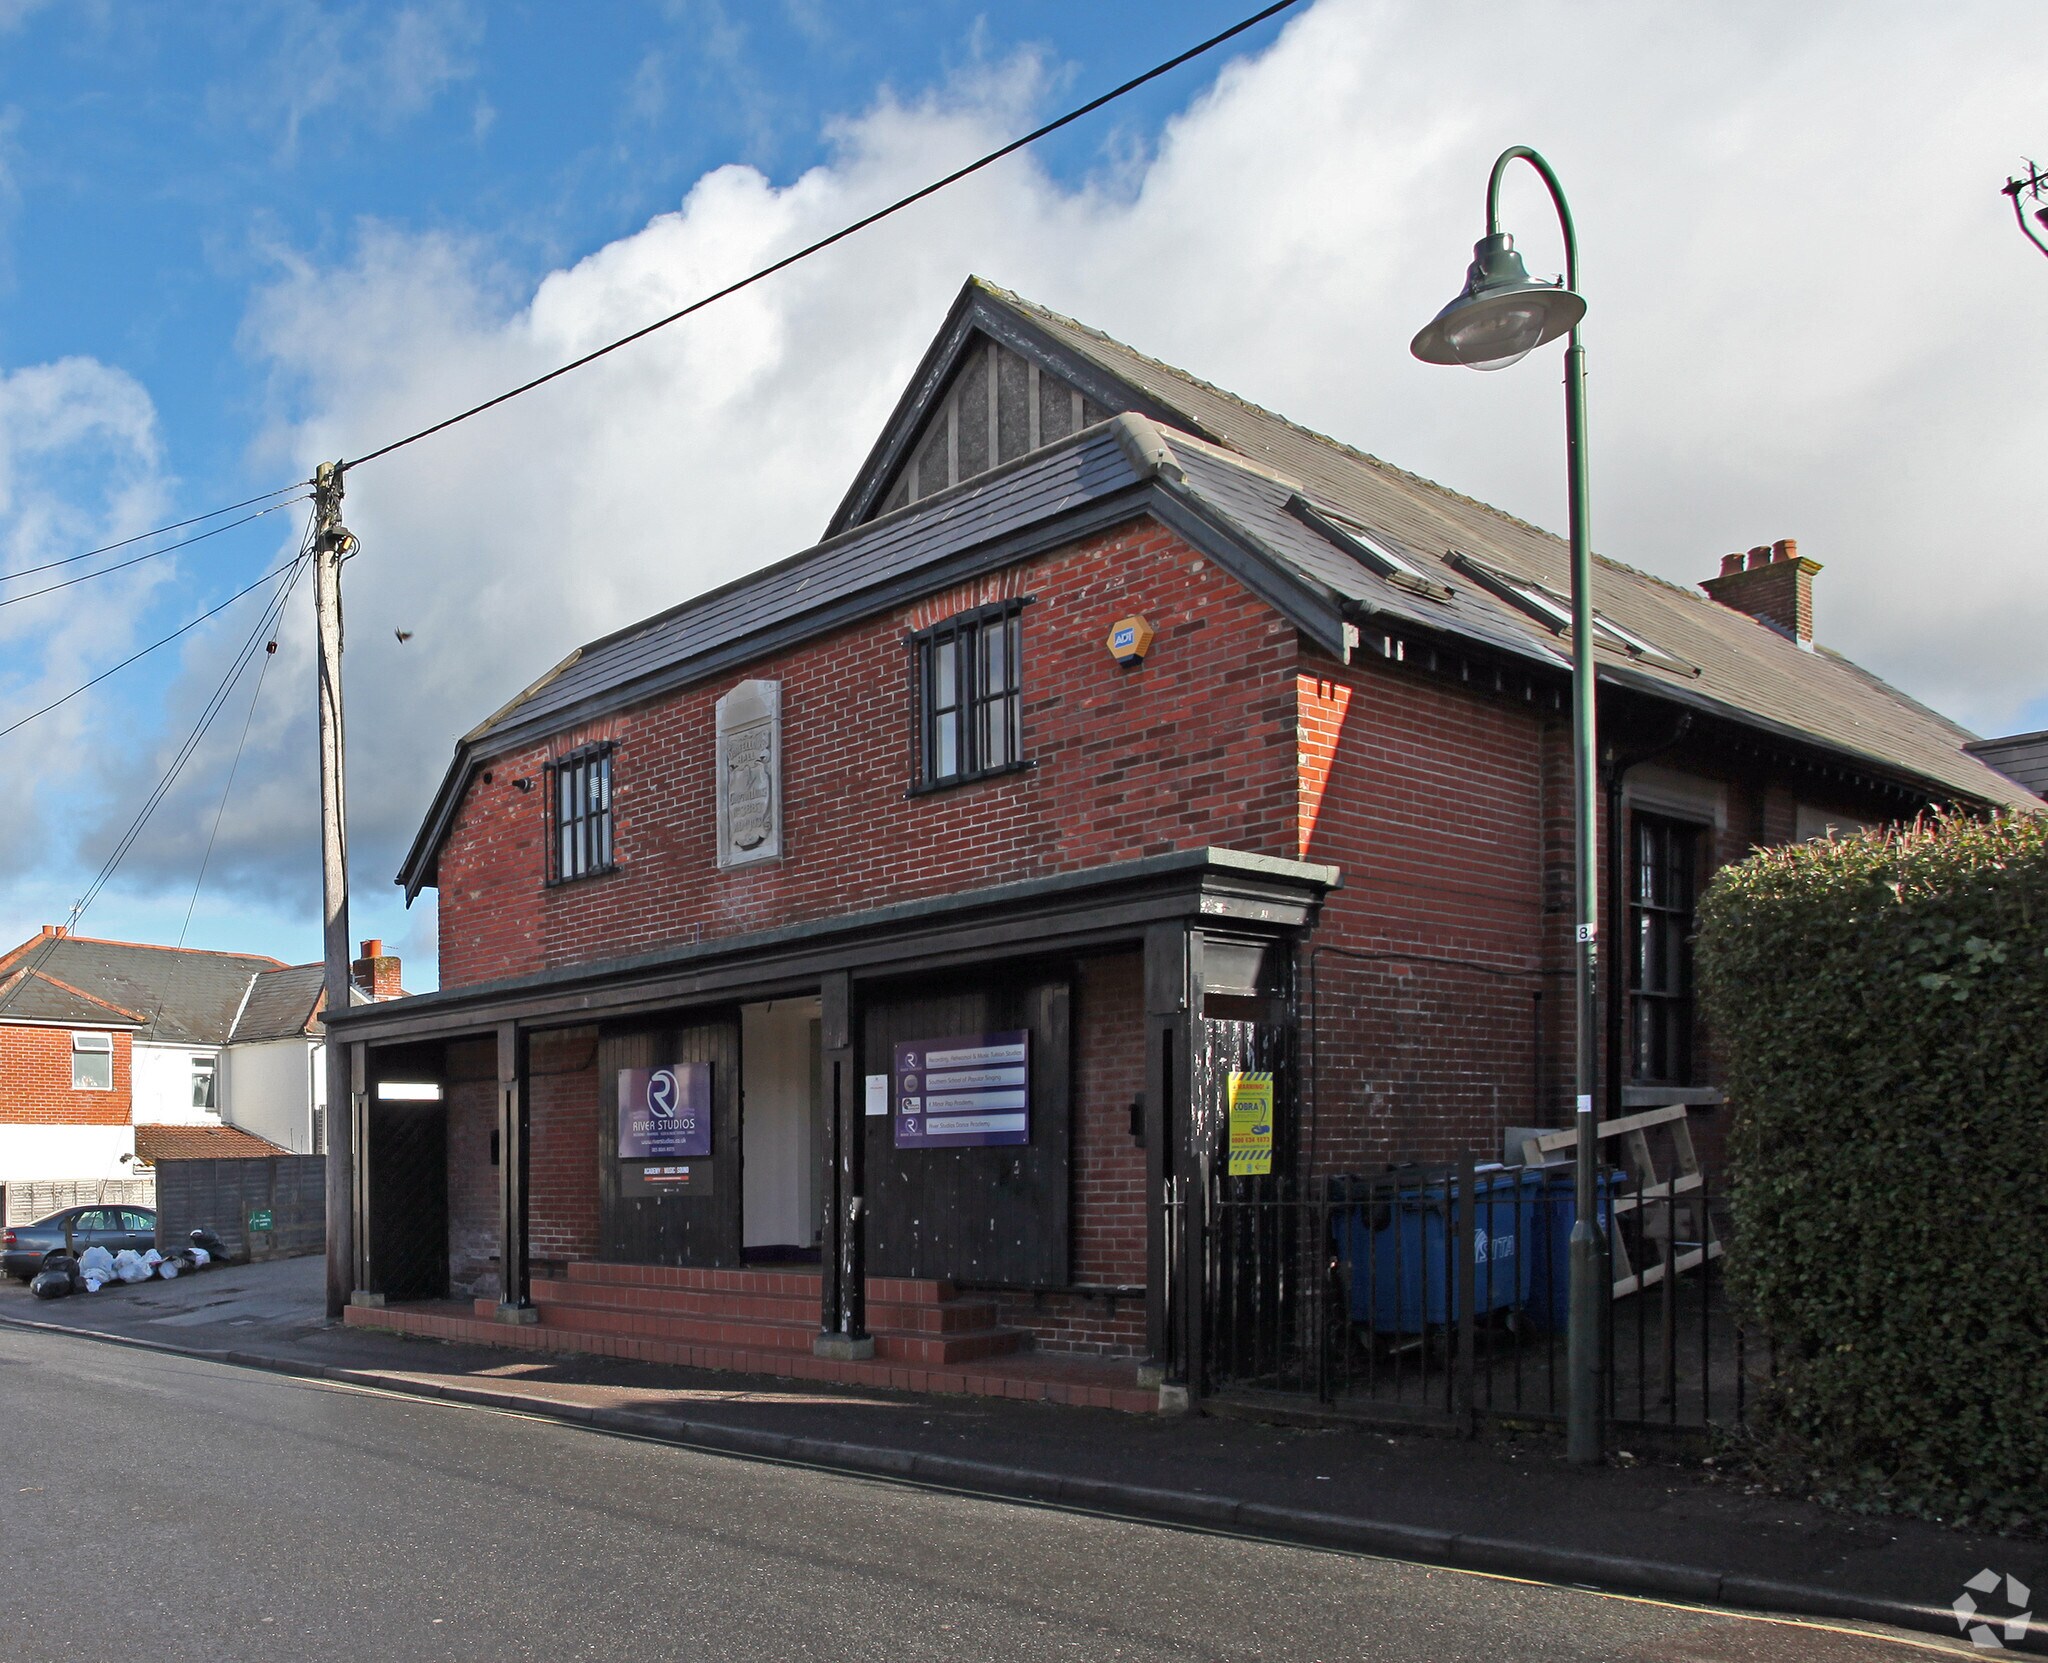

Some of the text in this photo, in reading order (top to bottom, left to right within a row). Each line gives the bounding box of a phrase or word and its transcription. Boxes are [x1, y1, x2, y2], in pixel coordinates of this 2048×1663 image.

[1116, 630, 1134, 646] ADT
[1580, 927, 1588, 939] 8
[1234, 1102, 1259, 1111] COBRA
[633, 1119, 695, 1131] RIVER STUDIOS
[644, 1167, 660, 1175] ACADEMY
